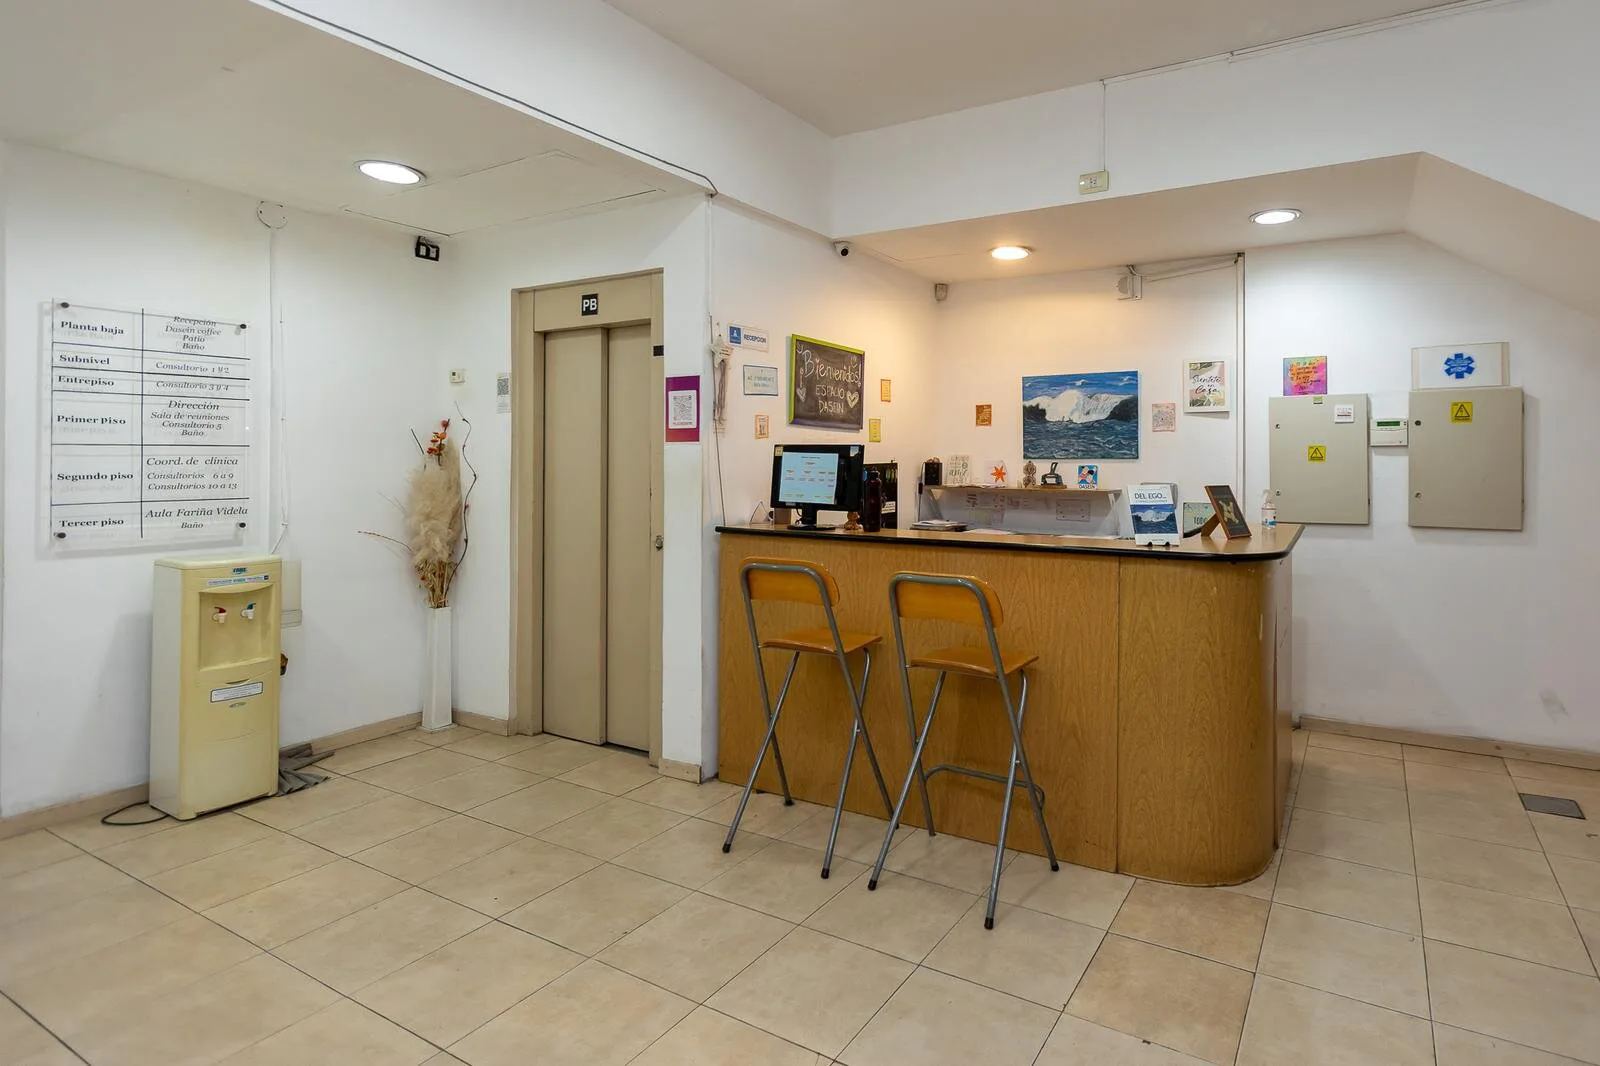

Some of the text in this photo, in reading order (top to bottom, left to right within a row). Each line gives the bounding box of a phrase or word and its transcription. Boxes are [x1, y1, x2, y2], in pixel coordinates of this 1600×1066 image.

[583, 298, 597, 311] PB
[173, 316, 217, 327] Recepción
[60, 320, 124, 335] Planta baja
[165, 325, 222, 336] Dasein coffee
[182, 334, 206, 343] Patio
[182, 342, 205, 350] Baño
[59, 354, 110, 366] Subnivel
[155, 361, 208, 372] Consultorio
[58, 375, 115, 387] Entrepiso
[156, 381, 208, 389] Consultorio
[168, 400, 220, 411] Dirección
[57, 415, 126, 427] Primer piso
[150, 412, 230, 421] Sala de reuniones
[162, 420, 222, 431] Consultorio 5
[181, 429, 205, 437] Baño
[146, 457, 183, 466] Coord.
[186, 457, 199, 466] de
[57, 473, 134, 482] Segundo piso
[147, 472, 205, 480] Consultorios
[212, 472, 219, 480] 6
[228, 473, 234, 481] 9
[148, 482, 206, 490] Consultorios
[228, 483, 237, 491] 13
[144, 506, 249, 518] Aula Fariña Videla
[59, 518, 124, 528] Tercer piso
[181, 521, 203, 529] Baño
